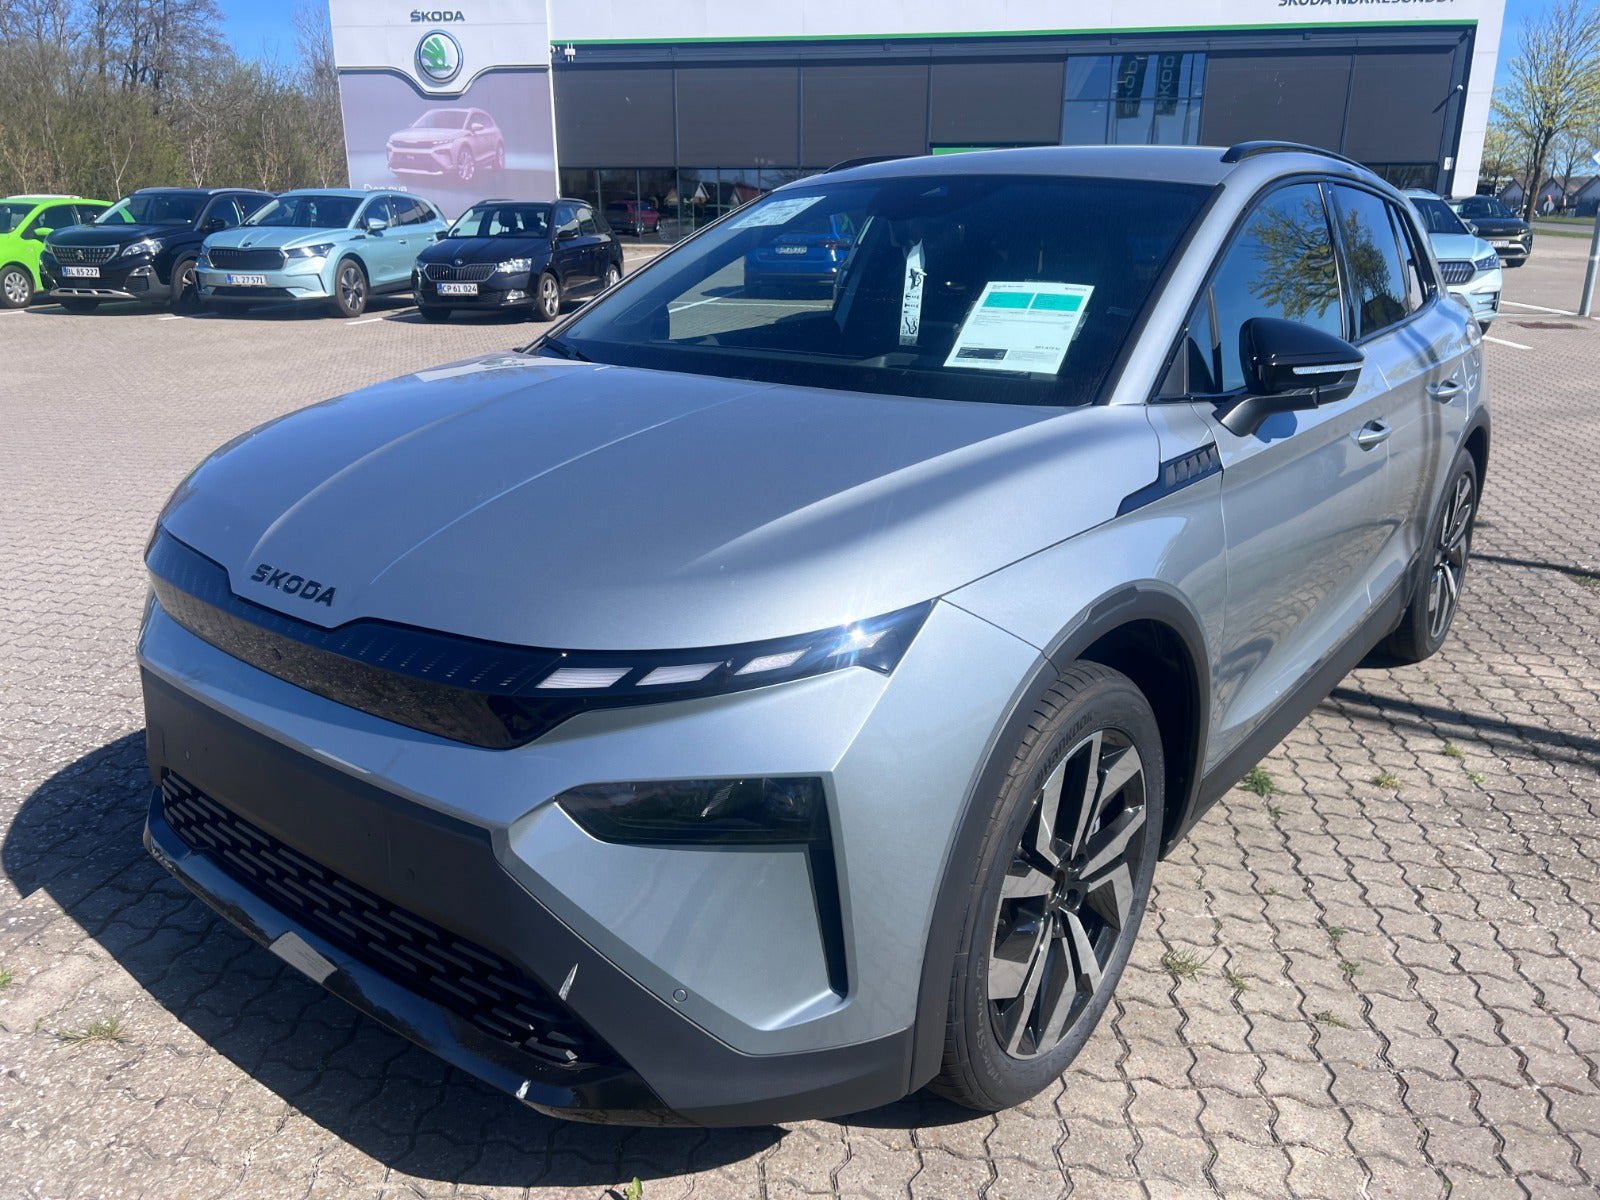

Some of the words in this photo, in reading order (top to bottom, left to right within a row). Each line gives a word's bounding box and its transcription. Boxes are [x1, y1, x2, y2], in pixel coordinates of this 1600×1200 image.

[410, 9, 465, 22] ŠKODA
[85, 268, 98, 276] 227
[250, 276, 263, 284] 571
[463, 284, 477, 293] 024
